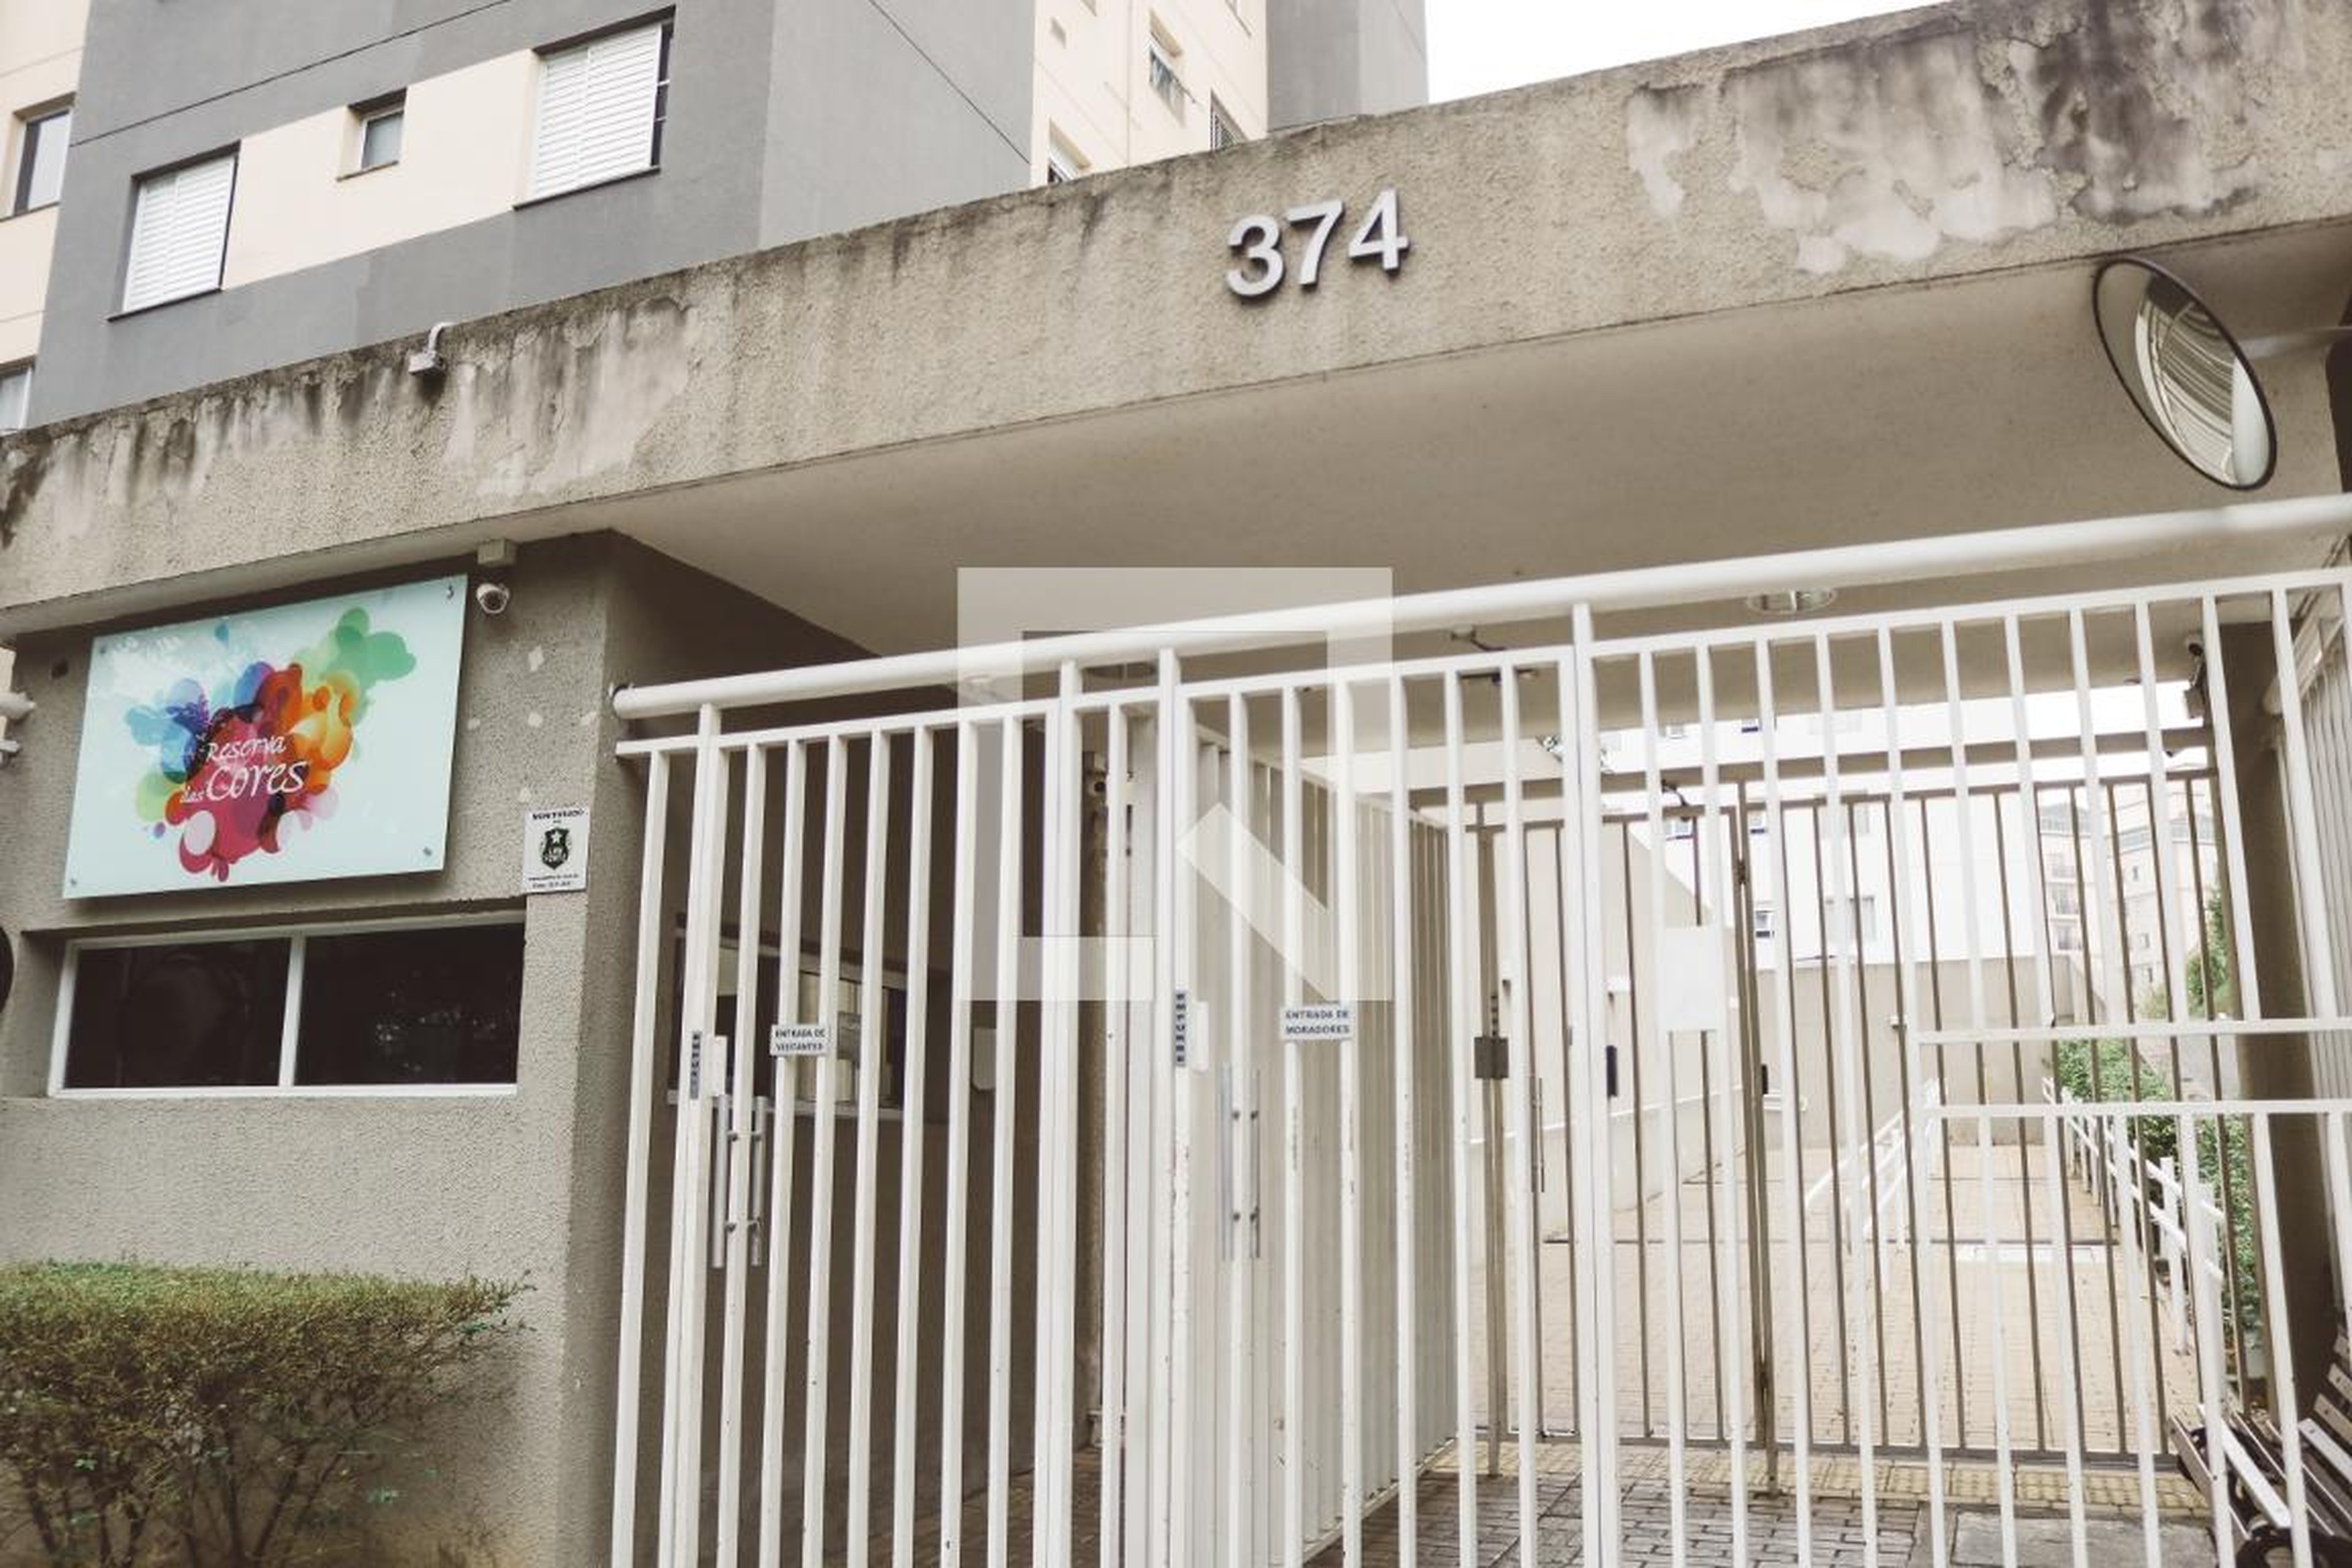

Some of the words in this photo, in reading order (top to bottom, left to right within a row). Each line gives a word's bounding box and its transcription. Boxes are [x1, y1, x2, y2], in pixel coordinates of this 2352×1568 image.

[1227, 188, 1409, 296] 374
[206, 736, 286, 761] Reserva
[206, 761, 308, 801] Cores
[1286, 1009, 1333, 1019] ENTRADA
[1286, 1025, 1349, 1034] MORADORES
